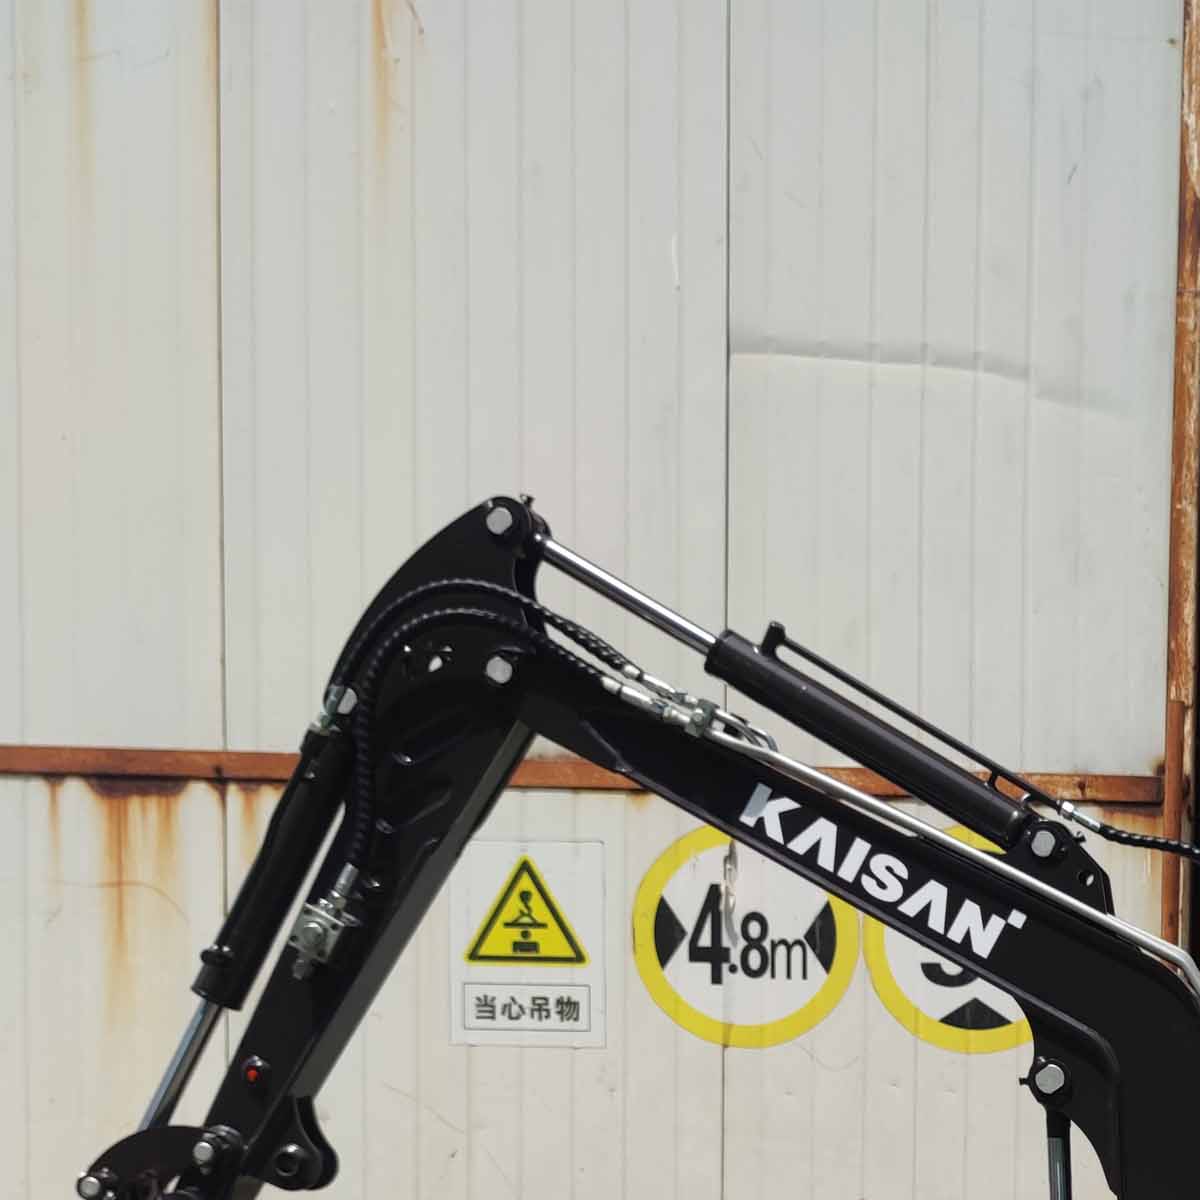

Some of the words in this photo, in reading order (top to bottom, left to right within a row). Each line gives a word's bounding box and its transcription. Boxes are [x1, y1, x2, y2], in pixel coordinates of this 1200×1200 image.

[739, 783, 1027, 959] KAISAN
[475, 994, 580, 1022] 当心吊物
